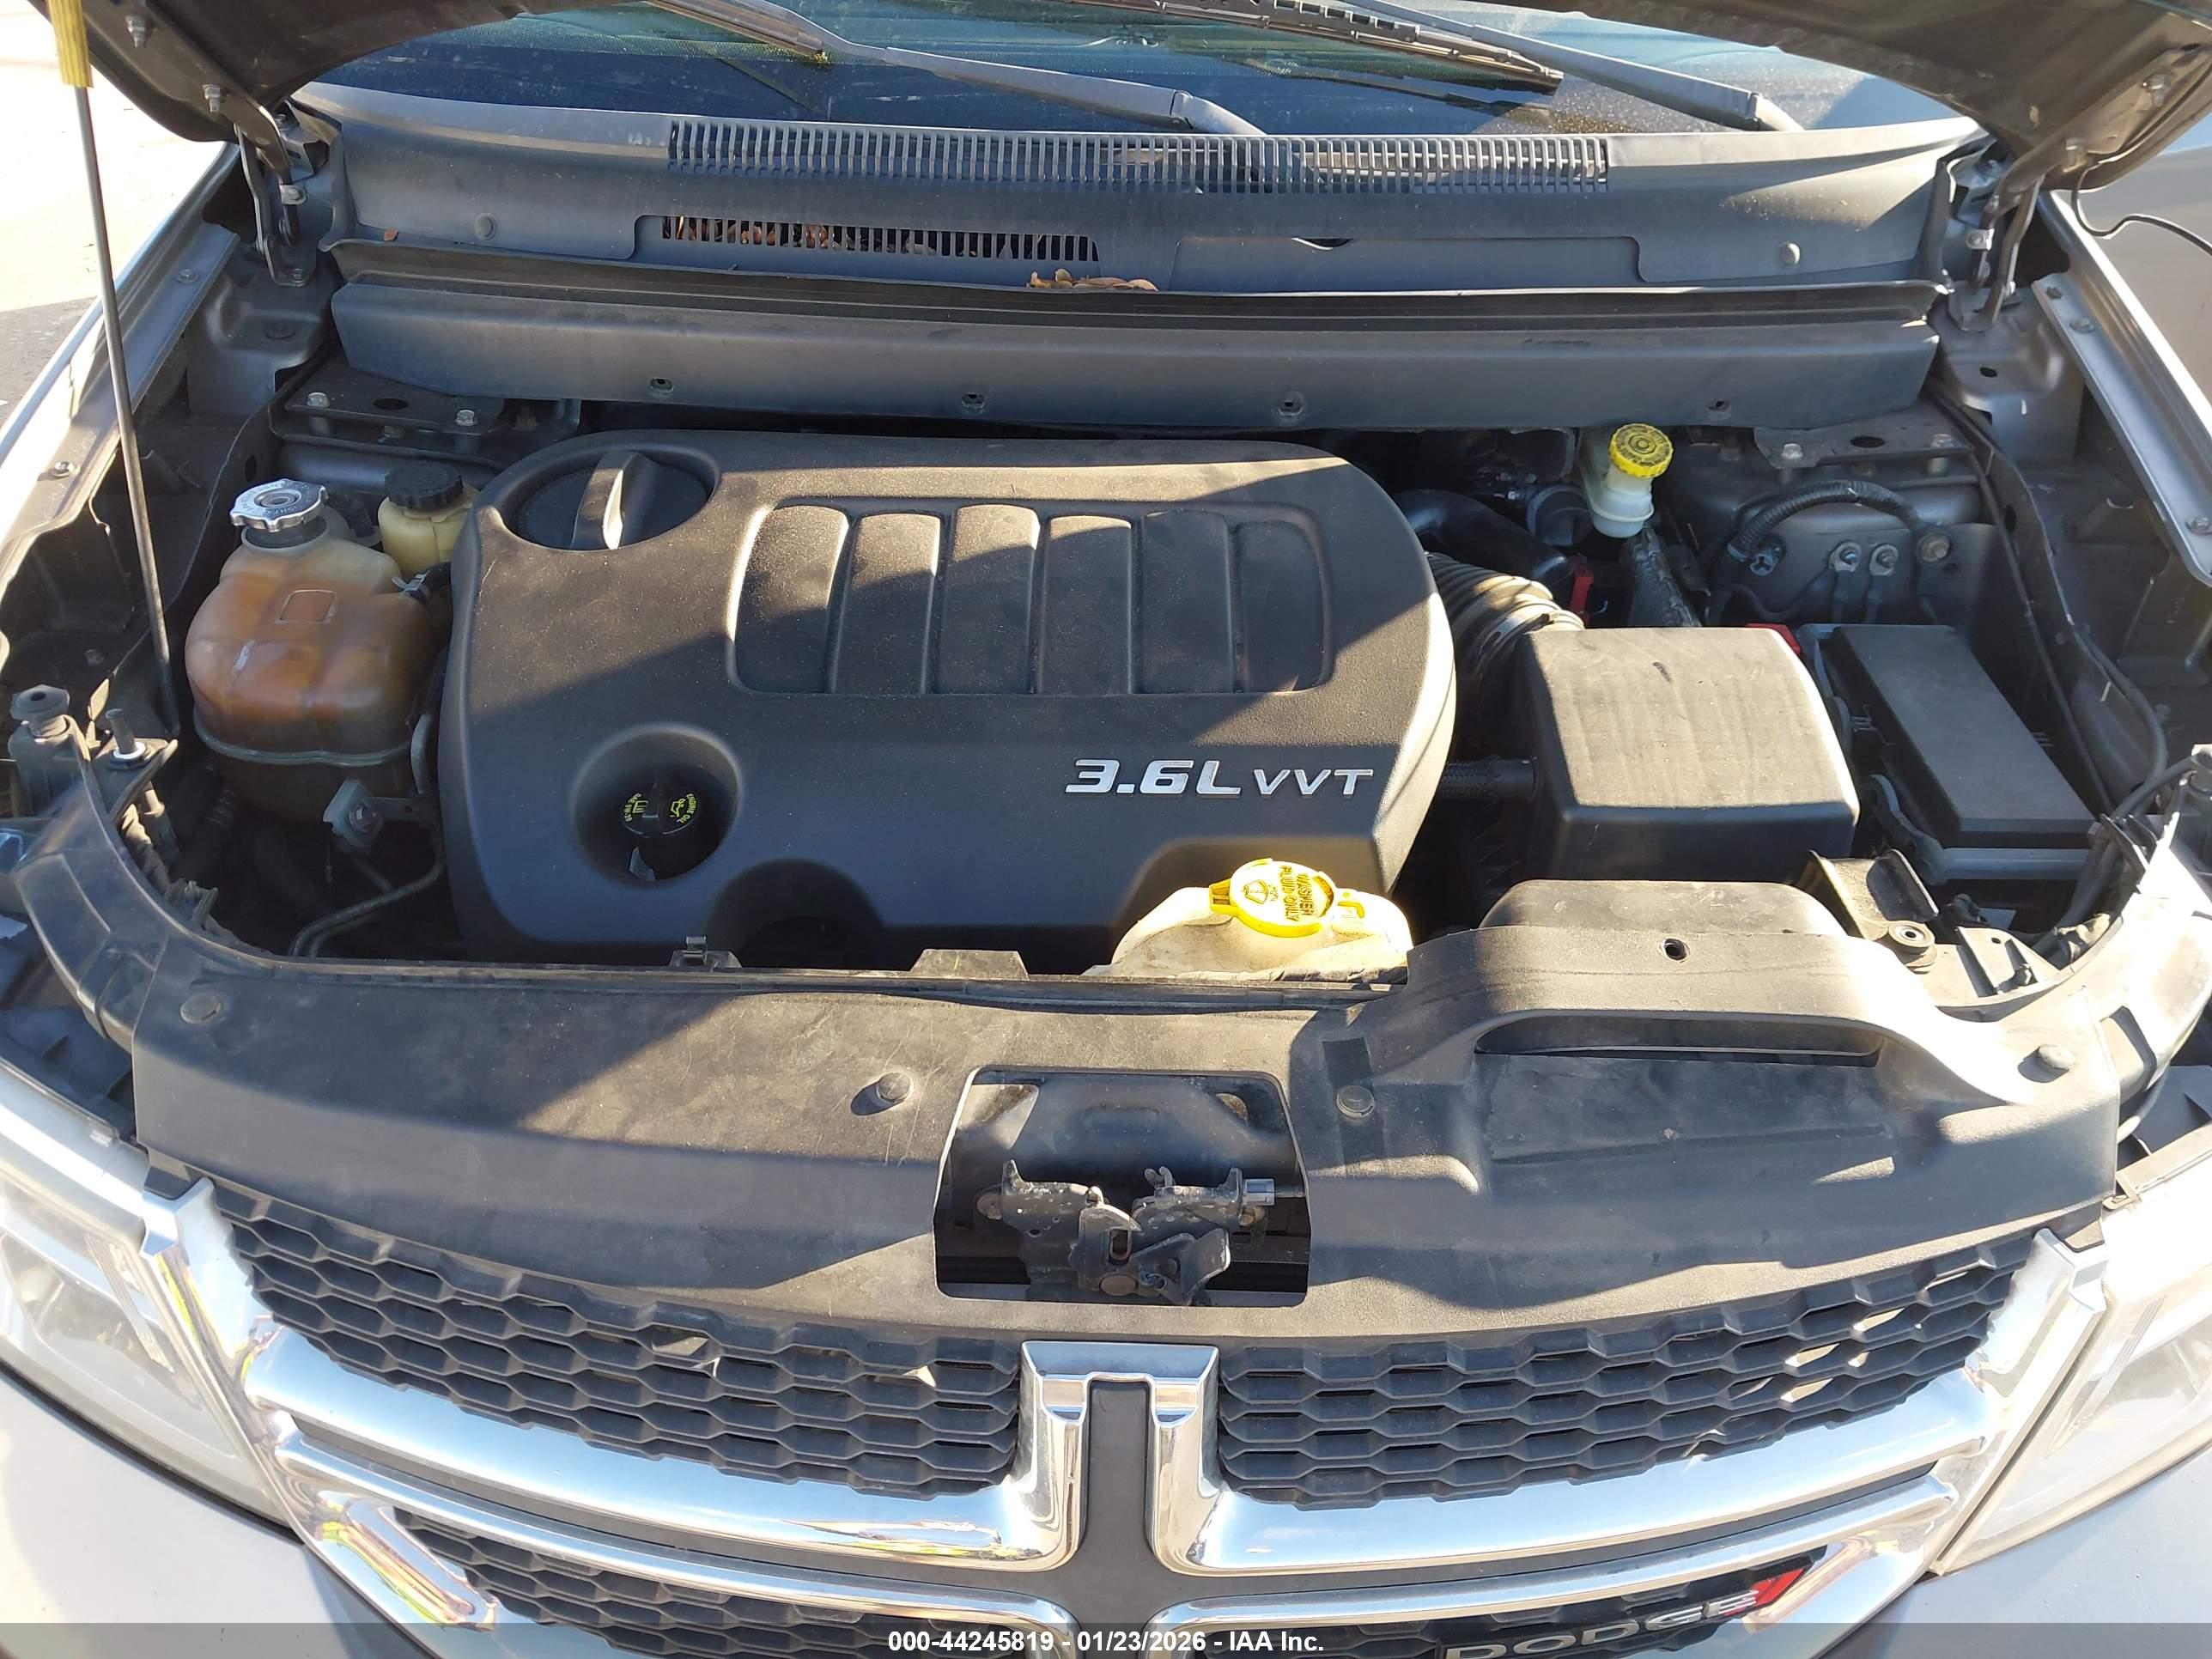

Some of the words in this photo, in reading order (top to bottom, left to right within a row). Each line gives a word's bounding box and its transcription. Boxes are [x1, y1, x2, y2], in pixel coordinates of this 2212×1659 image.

[1065, 759, 1242, 795] 3.6L
[1253, 769, 1374, 796] VVT
[686, 793, 697, 814] ENGINE
[676, 814, 691, 823] OIL
[1279, 865, 1295, 894] FLUID
[1284, 895, 1299, 921] ONLY
[1297, 873, 1315, 916] WASHER
[1444, 1589, 1759, 1659] DODGE
